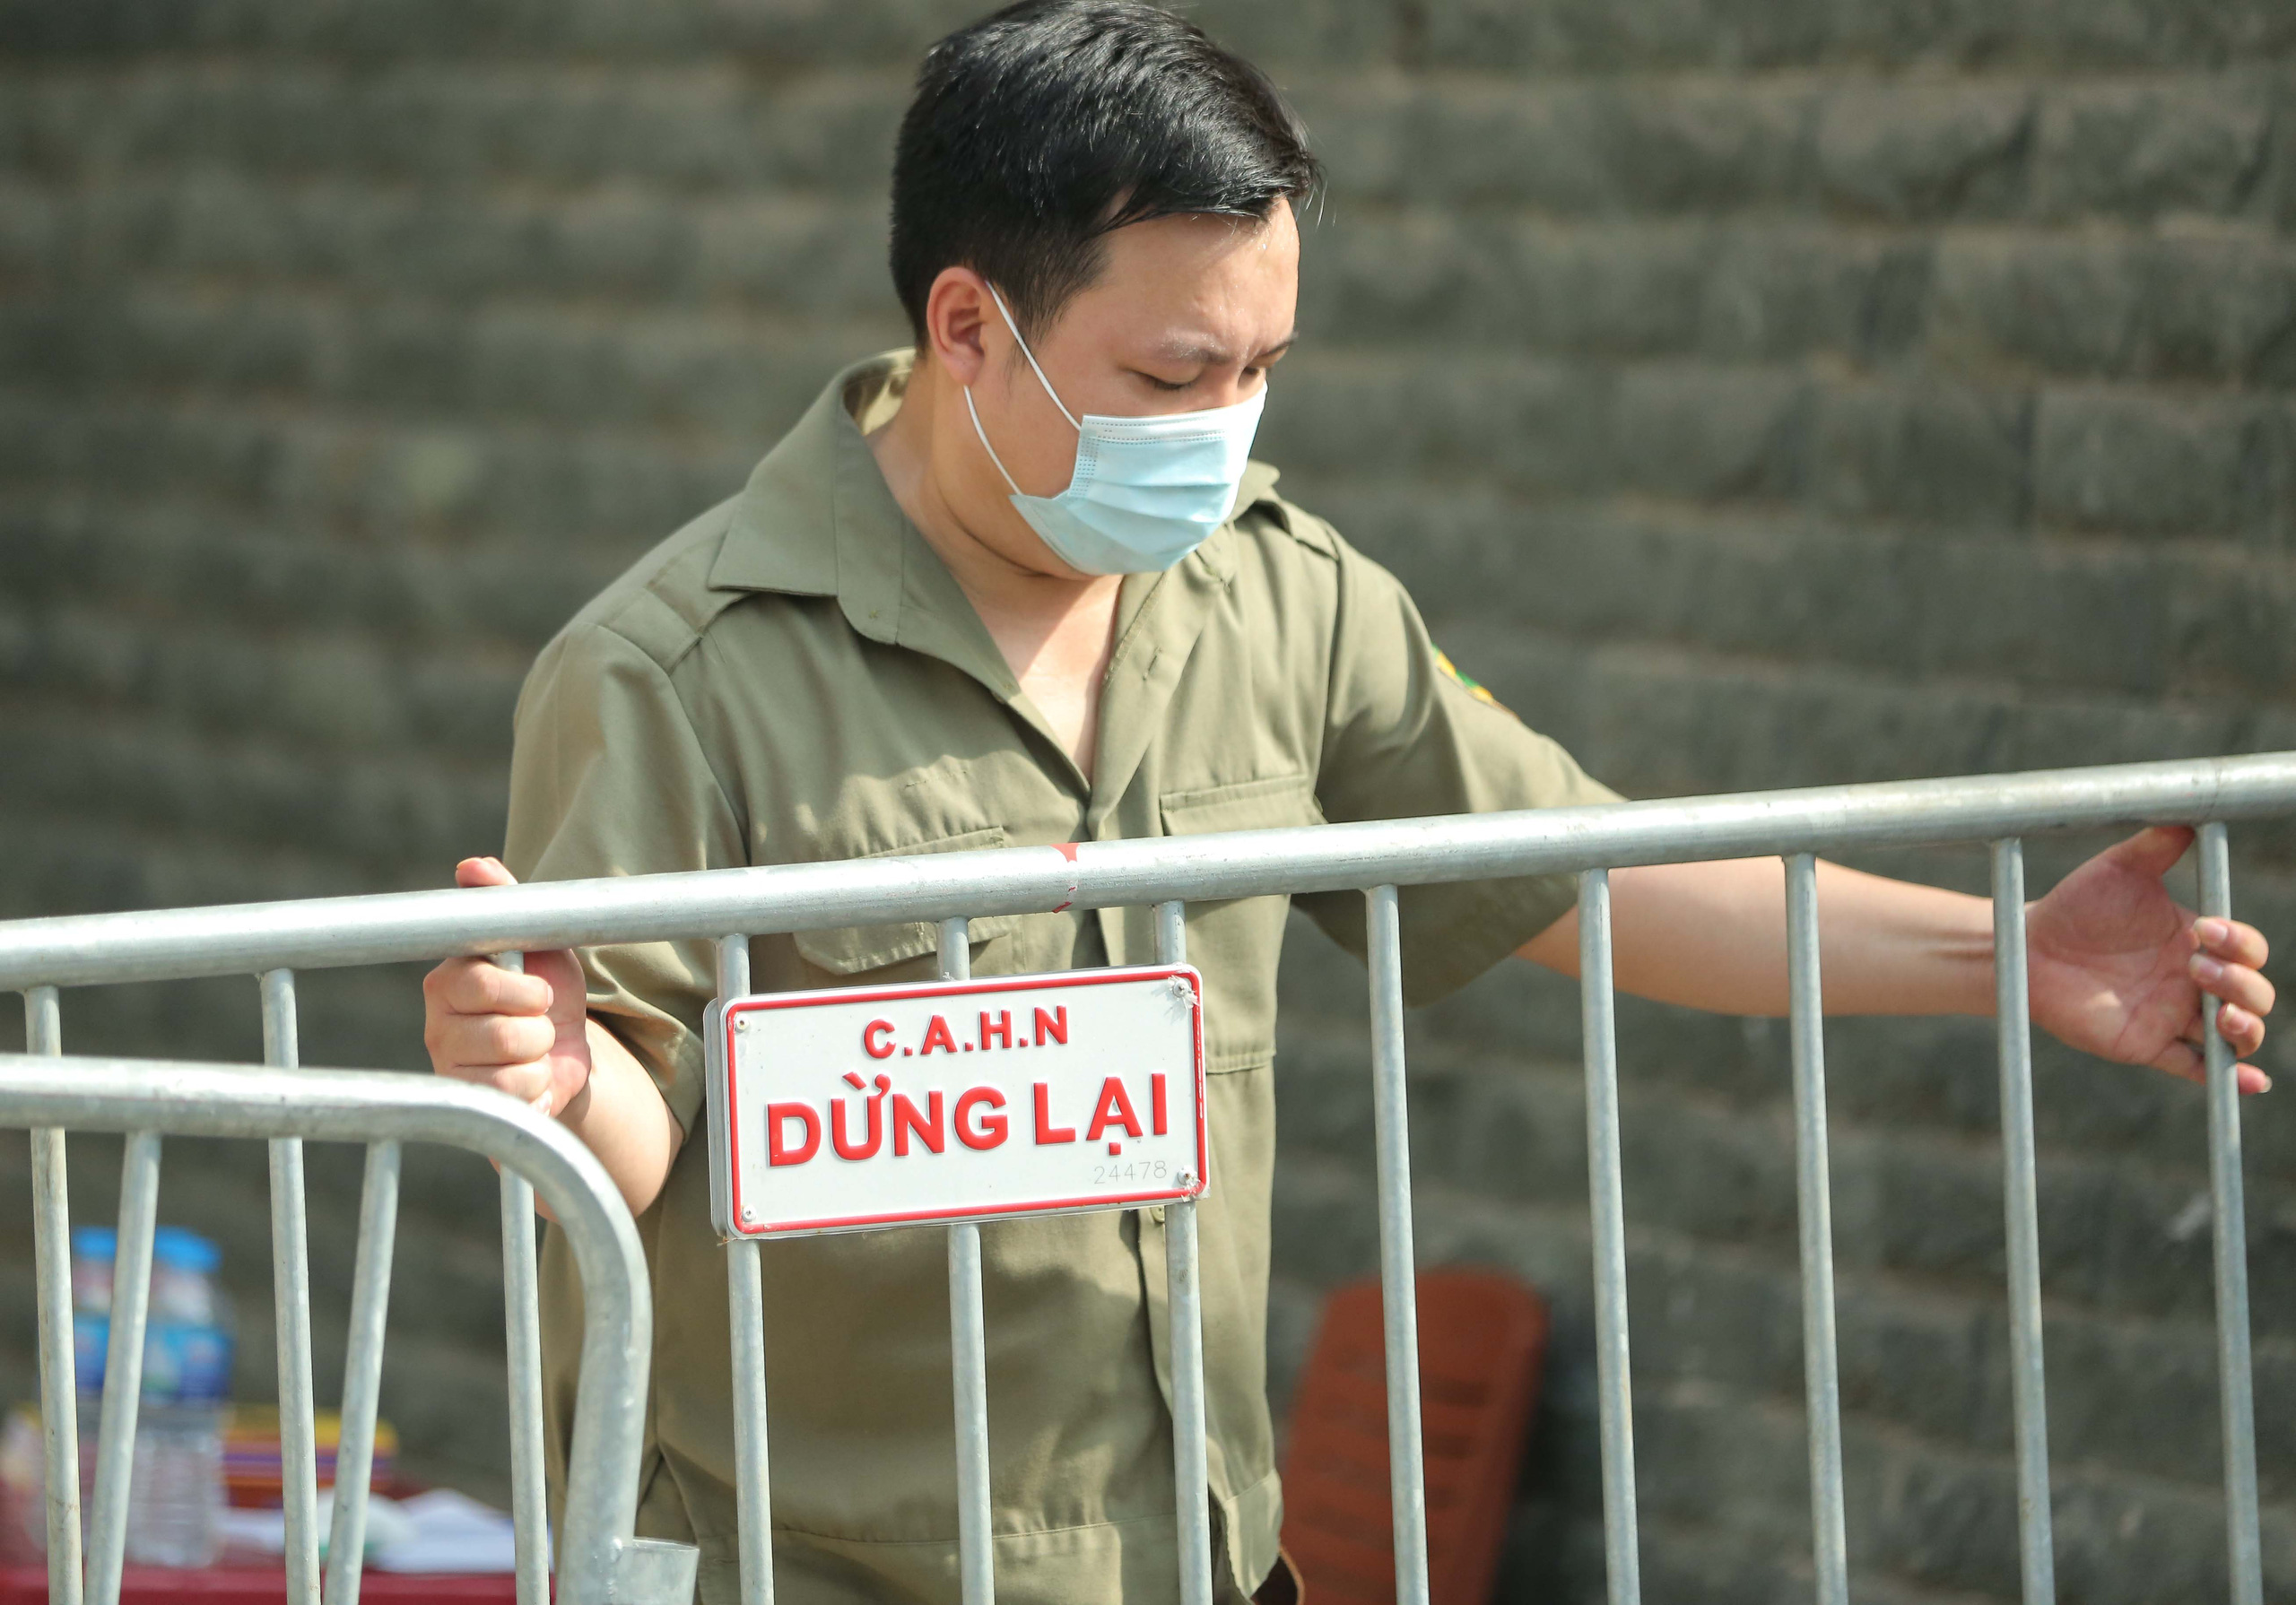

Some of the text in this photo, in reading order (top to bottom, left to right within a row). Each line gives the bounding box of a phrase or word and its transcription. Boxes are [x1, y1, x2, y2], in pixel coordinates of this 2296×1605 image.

[864, 1005, 1067, 1058] C.A.H.N
[767, 1071, 1167, 1167] DỪNG LẠI
[1093, 1160, 1167, 1184] 24478
